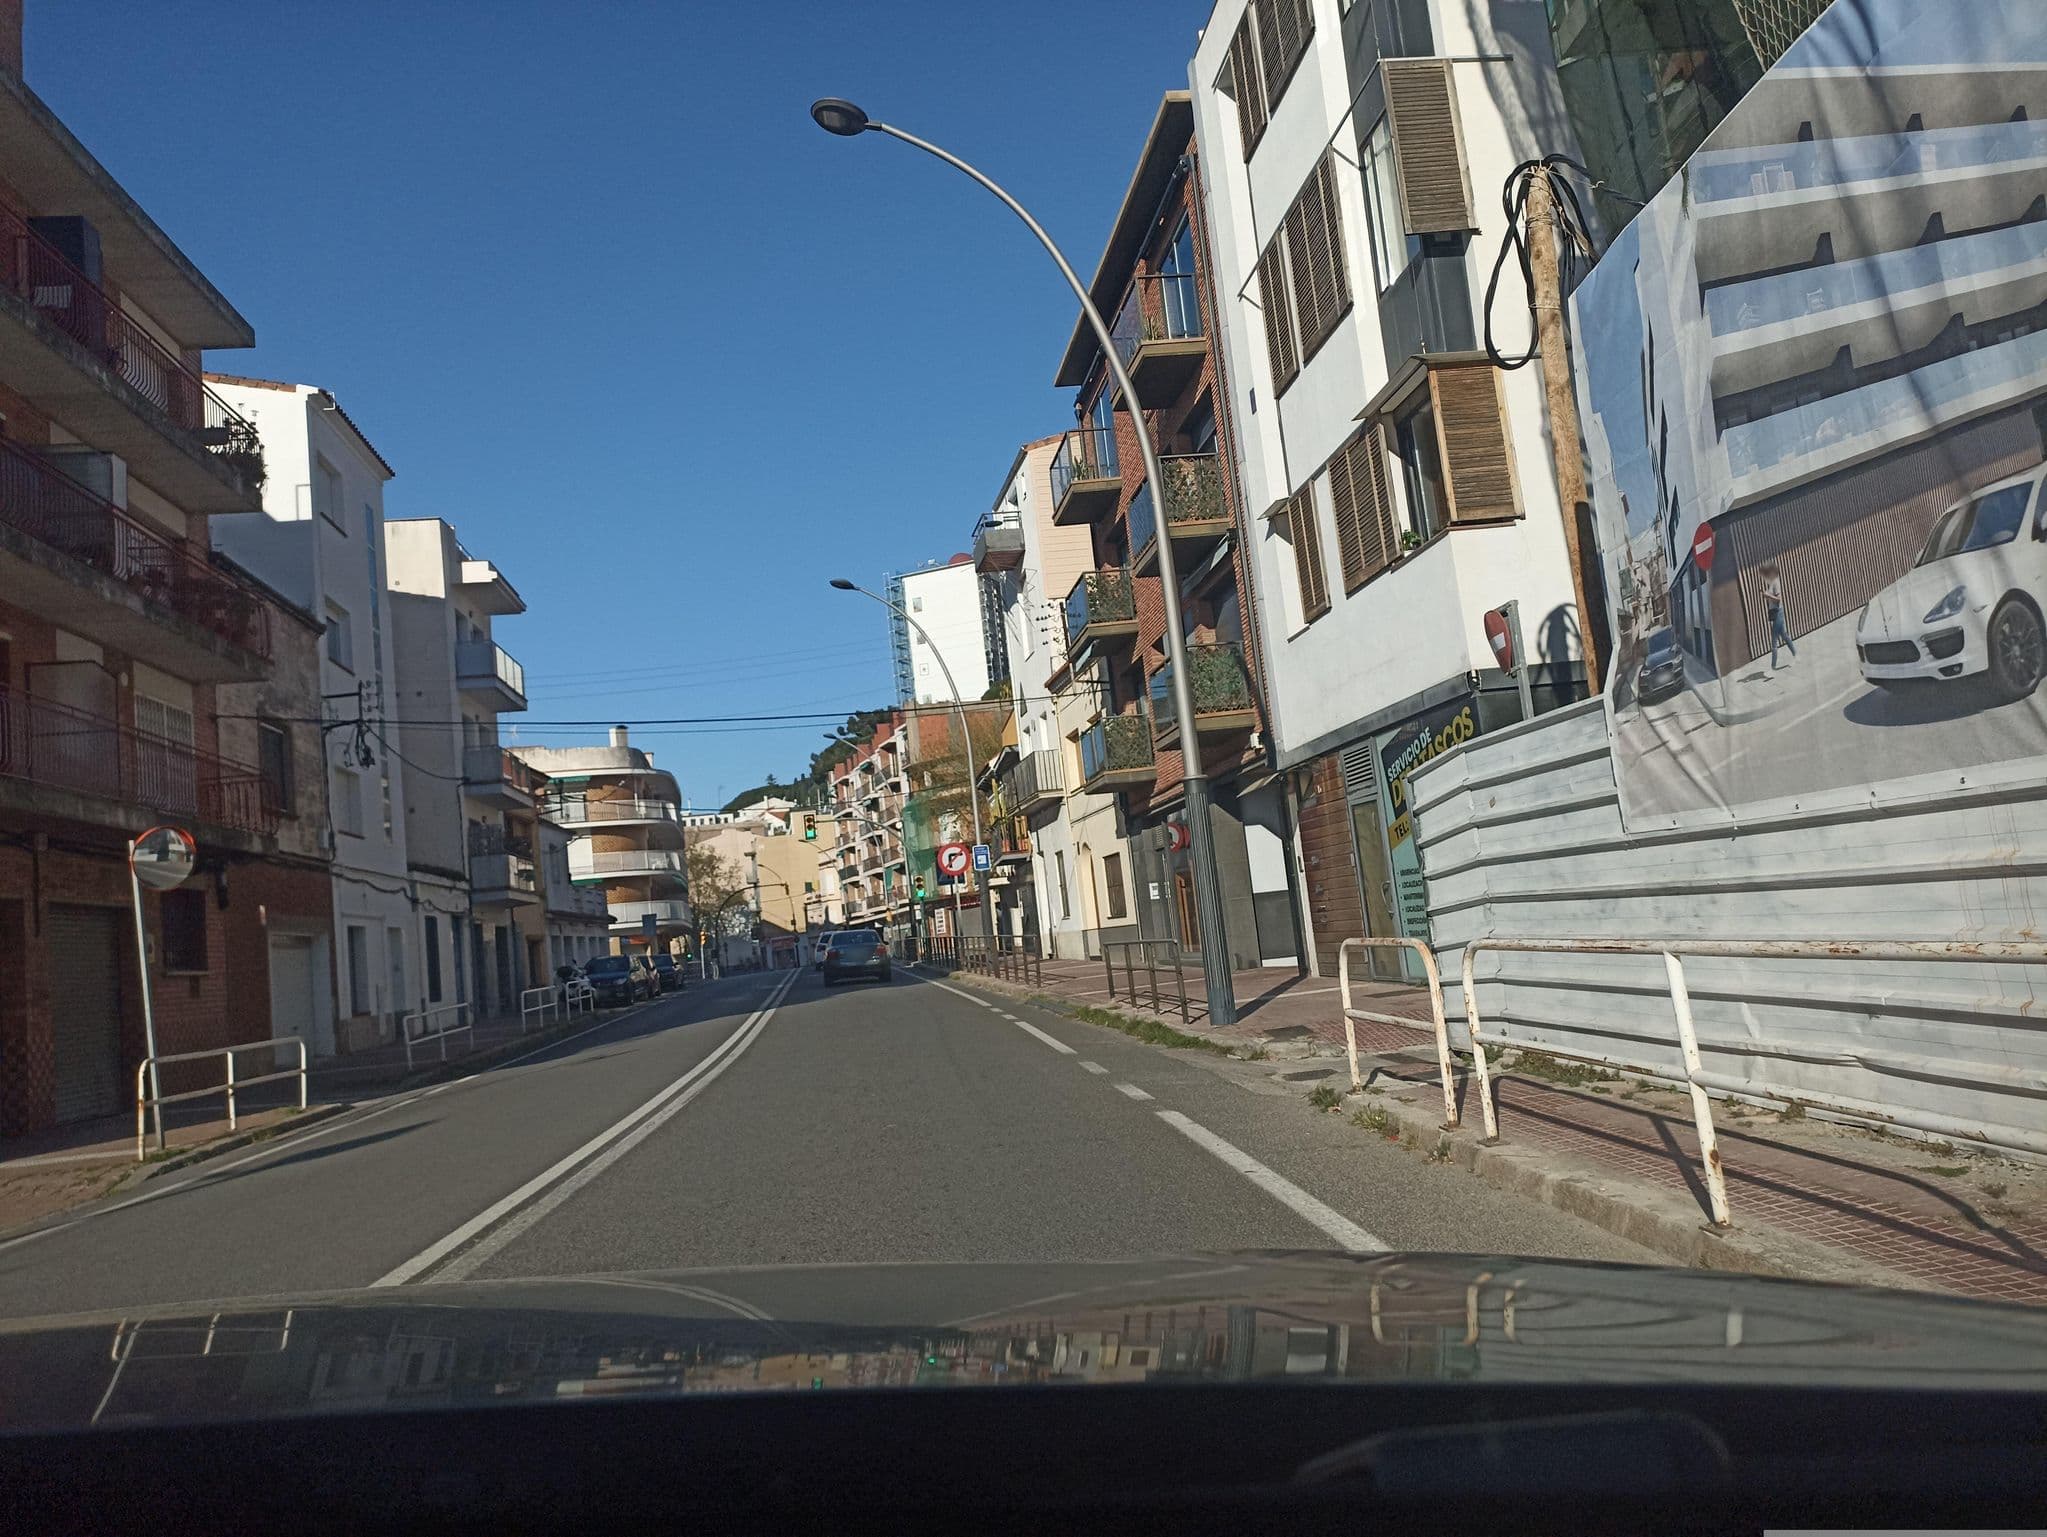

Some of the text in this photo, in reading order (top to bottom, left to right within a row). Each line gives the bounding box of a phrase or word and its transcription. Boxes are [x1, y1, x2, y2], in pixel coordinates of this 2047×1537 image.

[1387, 739, 1421, 781] SERVICIO
[1420, 726, 1432, 749] DE
[1391, 705, 1474, 808] DETASCOS
